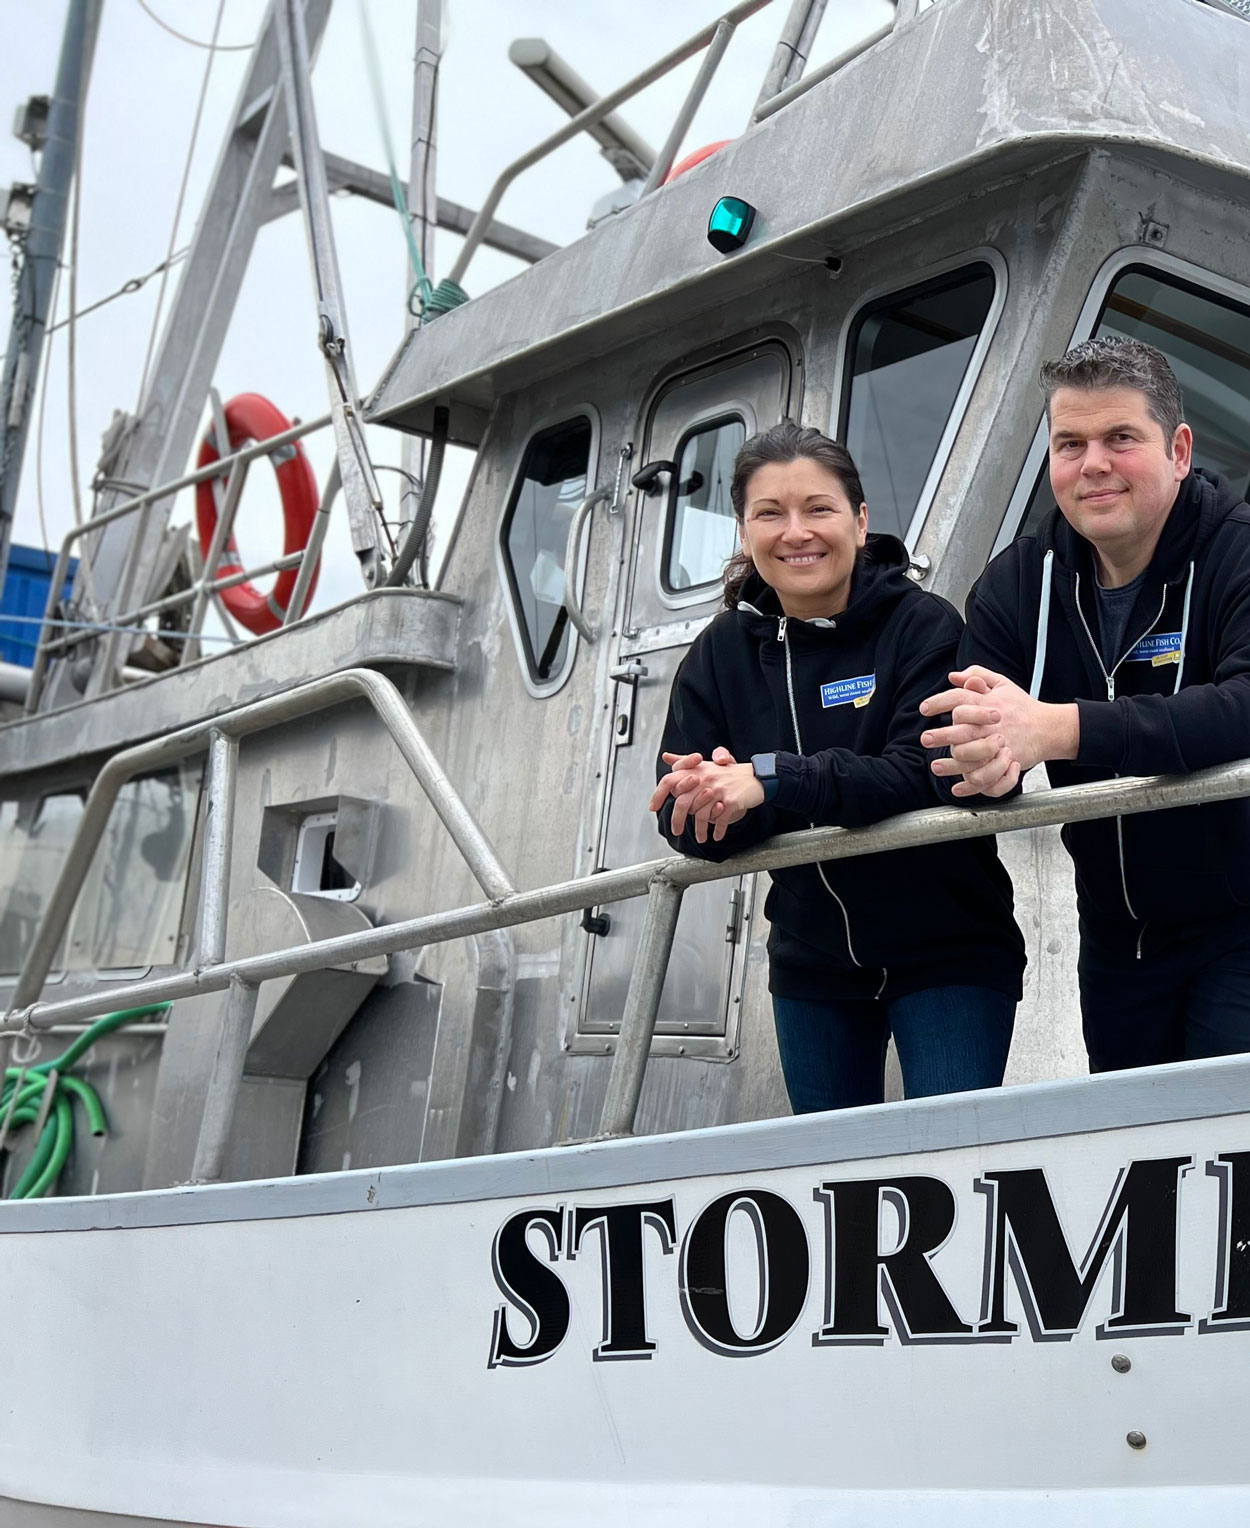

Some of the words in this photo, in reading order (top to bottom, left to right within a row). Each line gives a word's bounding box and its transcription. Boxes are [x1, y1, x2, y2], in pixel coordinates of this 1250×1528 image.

[1156, 638, 1169, 647] FISH
[824, 682, 856, 696] HIGHLINE
[857, 680, 872, 689] FISH
